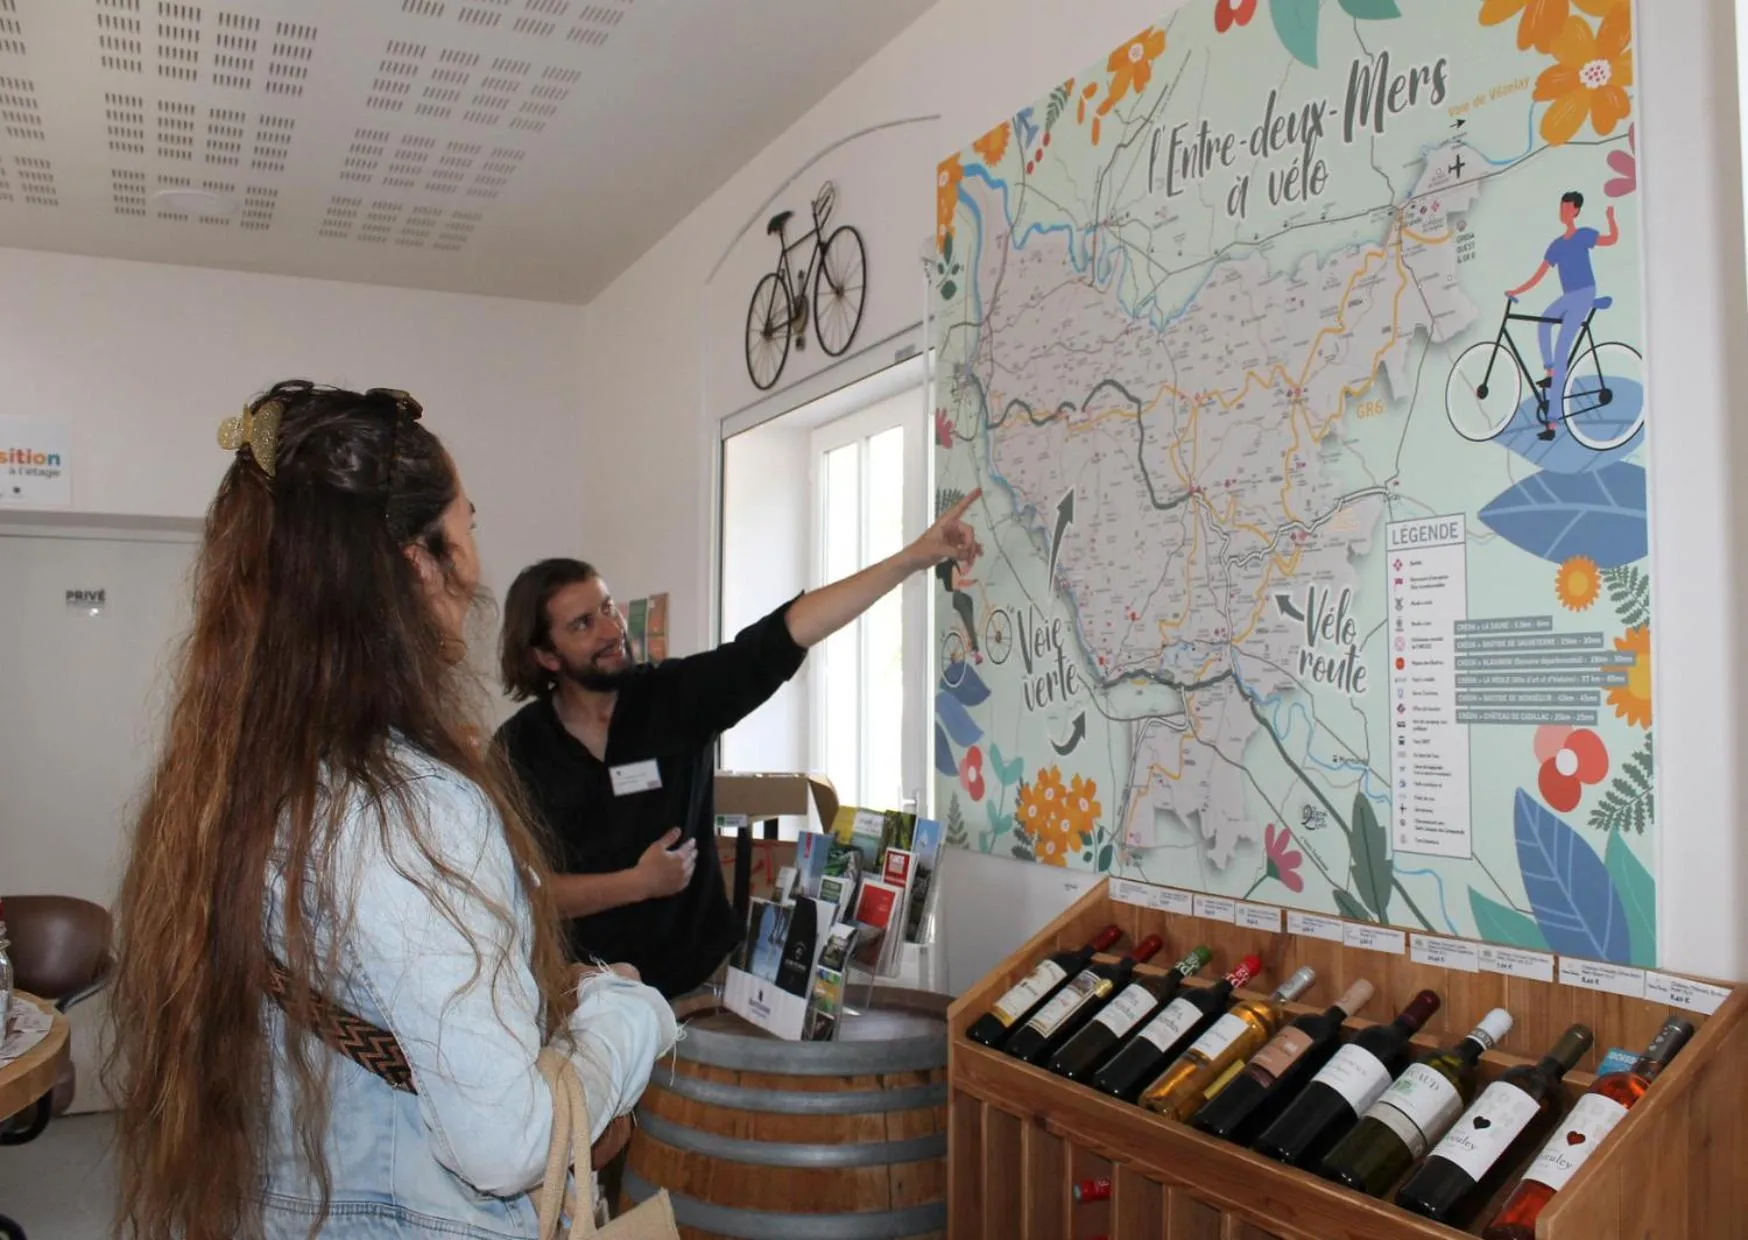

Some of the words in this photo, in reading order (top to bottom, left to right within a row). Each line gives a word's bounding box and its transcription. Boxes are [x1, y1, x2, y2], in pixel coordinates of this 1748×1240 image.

[1226, 172, 1249, 218] à
[1268, 131, 1330, 207] vélo
[1356, 399, 1384, 420] GR6
[1392, 522, 1459, 545] LÉGENDE
[65, 587, 106, 602] PRIVÉ
[1306, 586, 1357, 646] Vélo
[1017, 605, 1063, 674] Voie
[1023, 645, 1081, 712] verte
[1301, 643, 1368, 693] route
